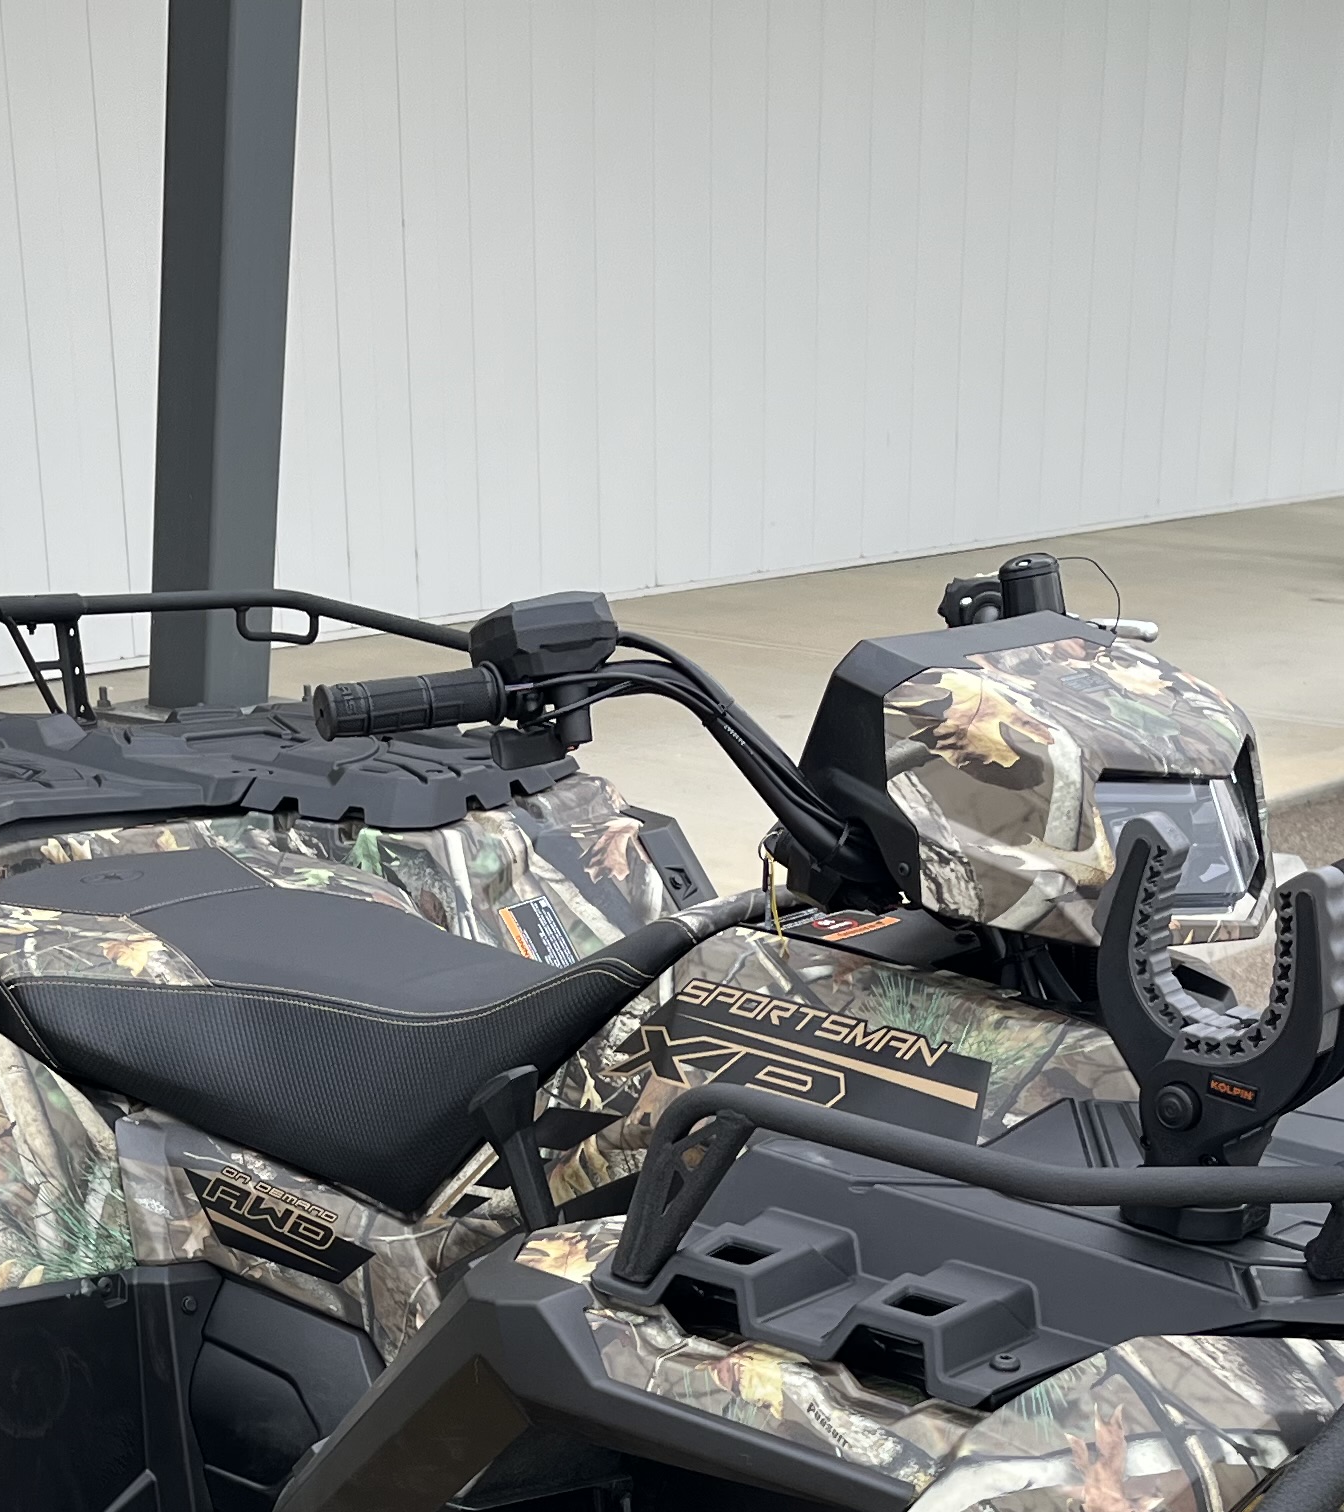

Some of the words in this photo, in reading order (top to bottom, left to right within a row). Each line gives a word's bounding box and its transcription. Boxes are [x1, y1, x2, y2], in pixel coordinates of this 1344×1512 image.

[676, 977, 949, 1068] SPORTSMAN
[1210, 1080, 1255, 1101] KOLPIN
[202, 1176, 337, 1250] AWD
[255, 1181, 339, 1223] DEMAND
